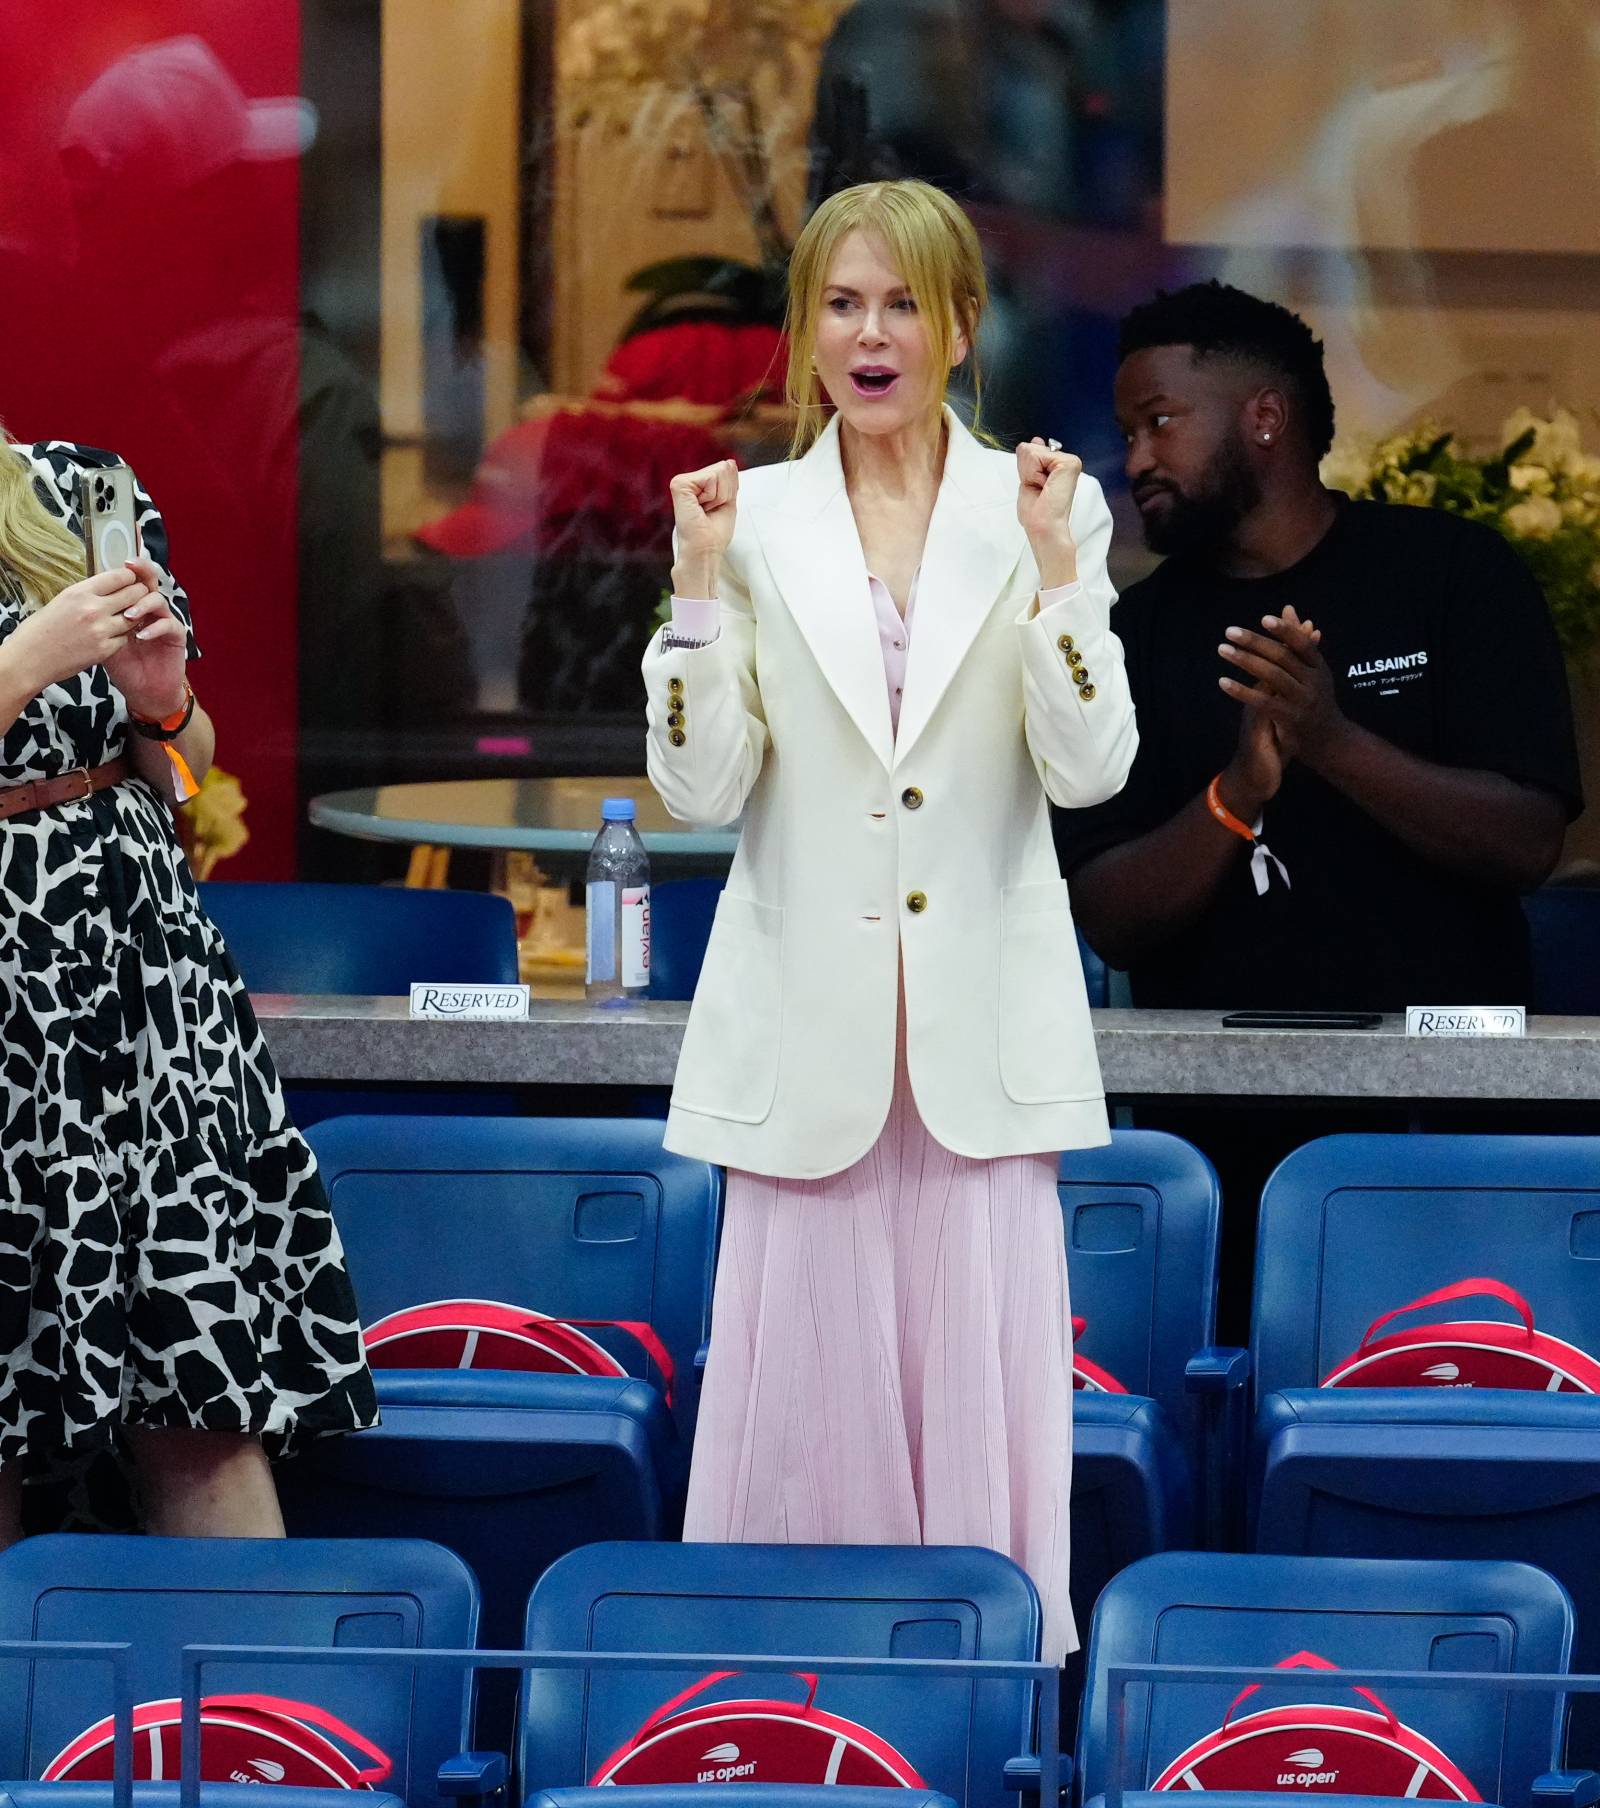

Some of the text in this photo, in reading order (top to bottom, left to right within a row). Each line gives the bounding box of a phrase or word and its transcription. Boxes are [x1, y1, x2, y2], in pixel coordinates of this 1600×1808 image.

[1347, 651, 1428, 678] ALLSAINTS
[640, 907, 650, 969] evian
[420, 989, 519, 1014] RESERVED
[697, 1769, 715, 1783] us
[1276, 1773, 1296, 1785] us
